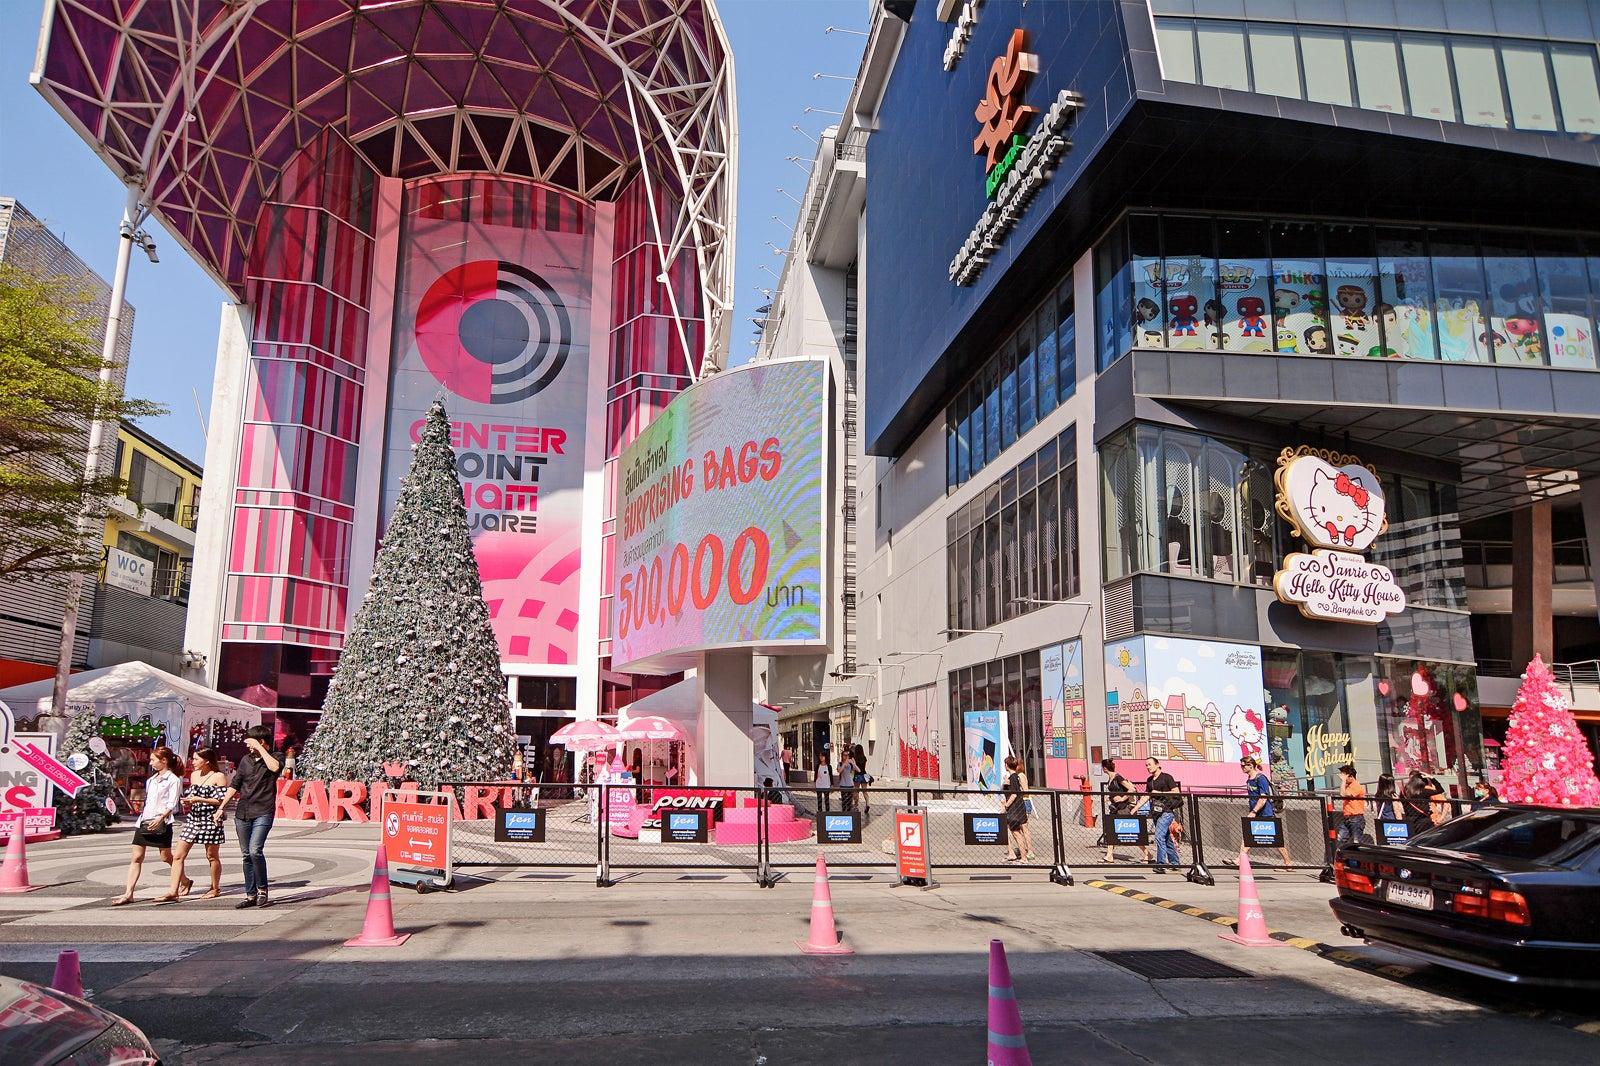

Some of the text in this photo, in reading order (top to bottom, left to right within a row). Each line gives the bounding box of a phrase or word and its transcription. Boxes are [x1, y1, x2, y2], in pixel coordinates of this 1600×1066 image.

[456, 452, 548, 482] OINT
[624, 436, 782, 541] SURPRISING BAGS
[117, 554, 146, 577] WOC
[1322, 553, 1369, 579] Sanrio
[619, 526, 804, 640] 500,000 บาท
[1289, 573, 1401, 606] Hello Kitty House
[1330, 602, 1365, 617] Bangkok
[1306, 724, 1350, 752] Happy
[44, 761, 77, 788] CELEBRATE
[1304, 747, 1358, 780] Holiday!
[652, 795, 724, 813] POINT
[25, 817, 52, 826] BAGS
[1407, 886, 1430, 899] 3347
